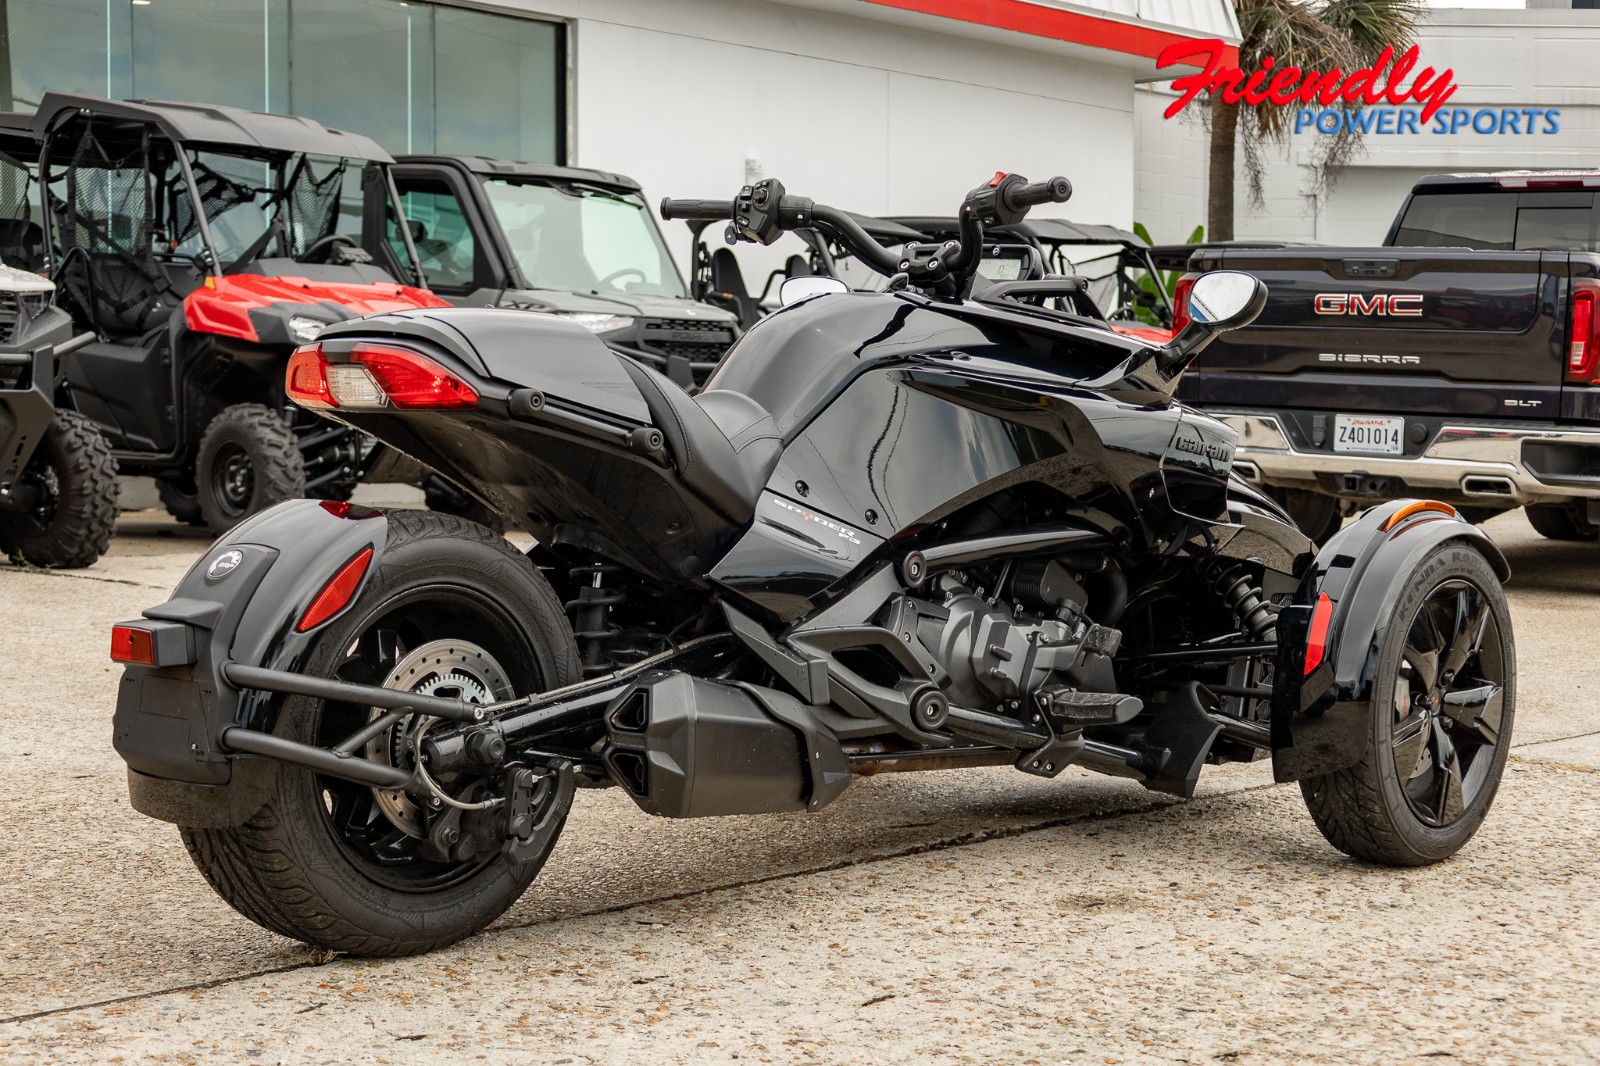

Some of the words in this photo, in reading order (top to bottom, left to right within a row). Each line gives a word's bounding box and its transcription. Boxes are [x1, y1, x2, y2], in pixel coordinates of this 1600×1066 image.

[1314, 293, 1424, 317] GMC
[1318, 353, 1421, 365] SIERRA
[1504, 399, 1542, 407] SLT
[1339, 426, 1399, 445] Z401014
[773, 498, 855, 537] SPYDER
[1398, 557, 1447, 622] KENDA
